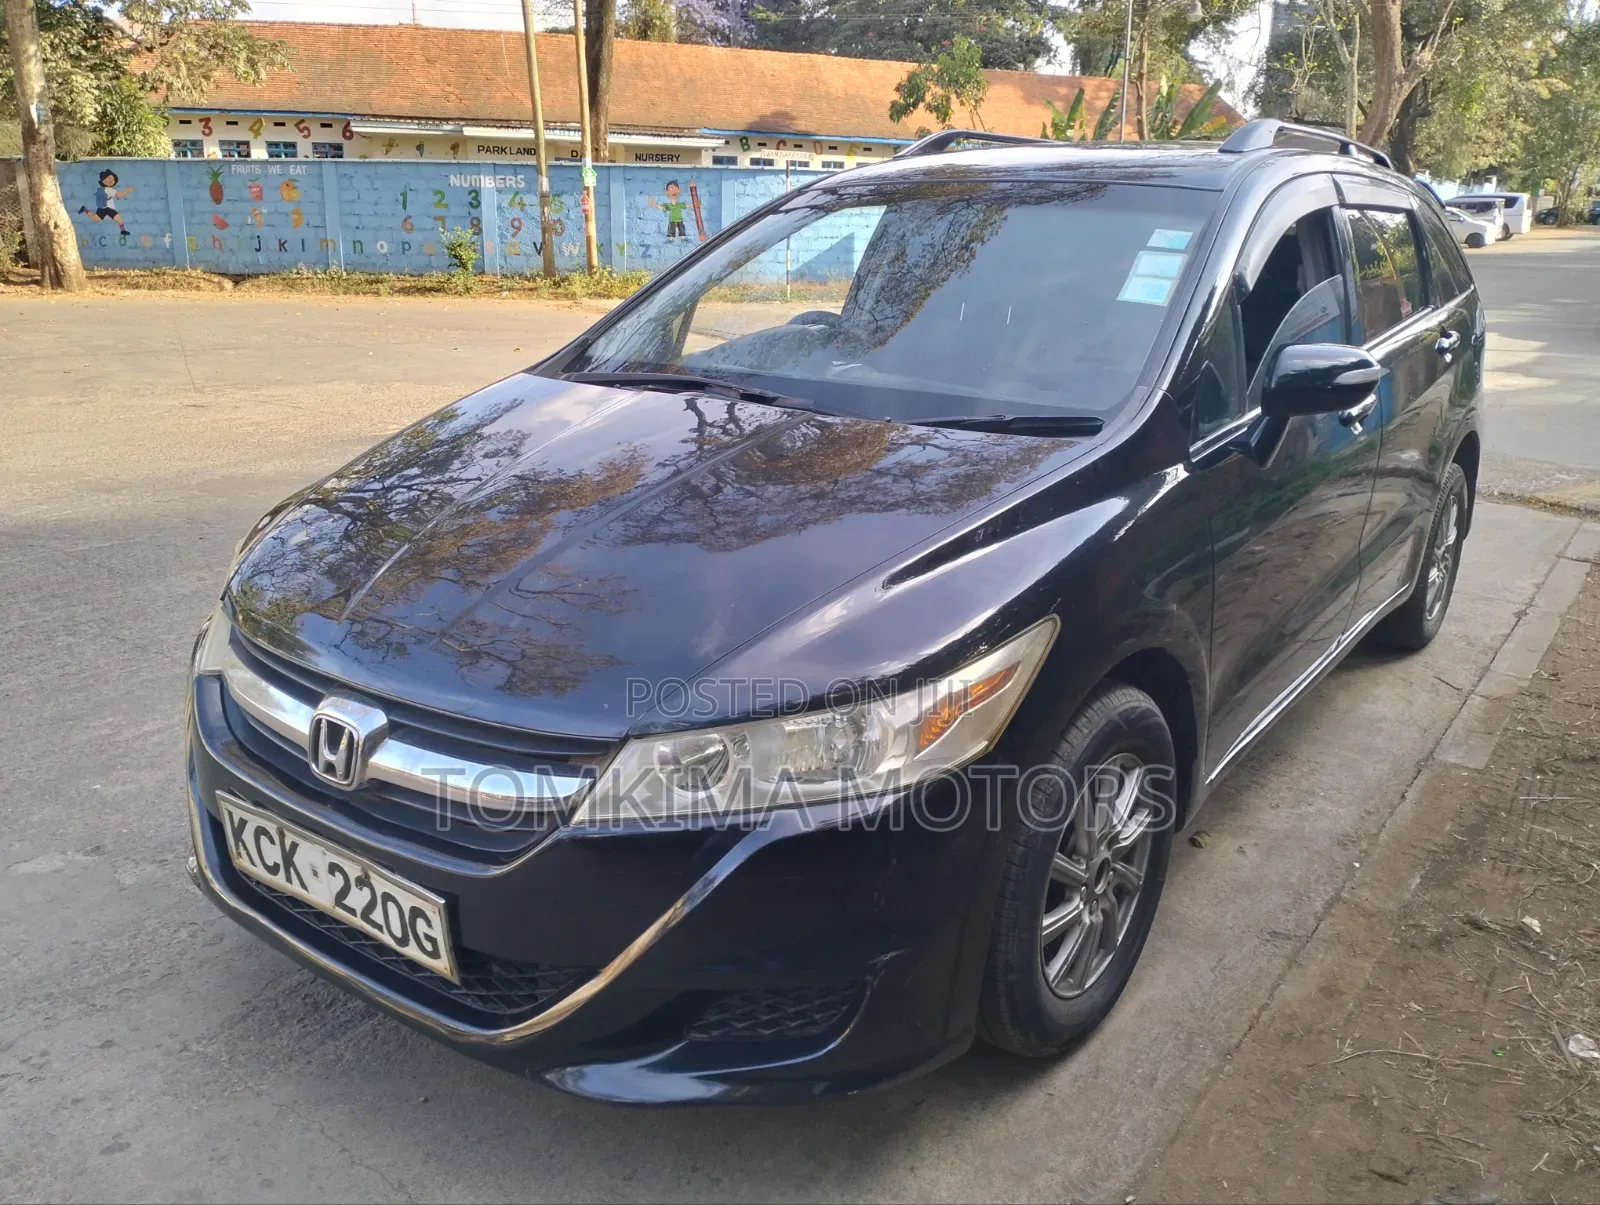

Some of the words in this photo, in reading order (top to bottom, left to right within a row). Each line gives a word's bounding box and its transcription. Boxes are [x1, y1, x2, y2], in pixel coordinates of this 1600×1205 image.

[199, 117, 213, 137] 3
[248, 117, 265, 139] 4
[294, 119, 311, 139] 5
[342, 120, 354, 141] 6
[739, 136, 750, 152] B
[813, 140, 824, 155] D
[635, 152, 680, 162] NURSERY
[231, 164, 261, 175] FRUITS
[268, 165, 282, 175] WE
[290, 165, 307, 175] EAT
[450, 174, 526, 188] NUMBERS
[400, 189, 408, 211] 1
[433, 190, 448, 209] 2
[468, 189, 481, 209] 3
[509, 191, 526, 212] 4
[402, 216, 414, 234] 6
[470, 216, 482, 235] 8
[510, 217, 523, 238] 9
[255, 235, 261, 252] j
[319, 238, 336, 252] m
[353, 240, 363, 254] n
[226, 807, 310, 893] KCK
[327, 861, 442, 960] 220G
